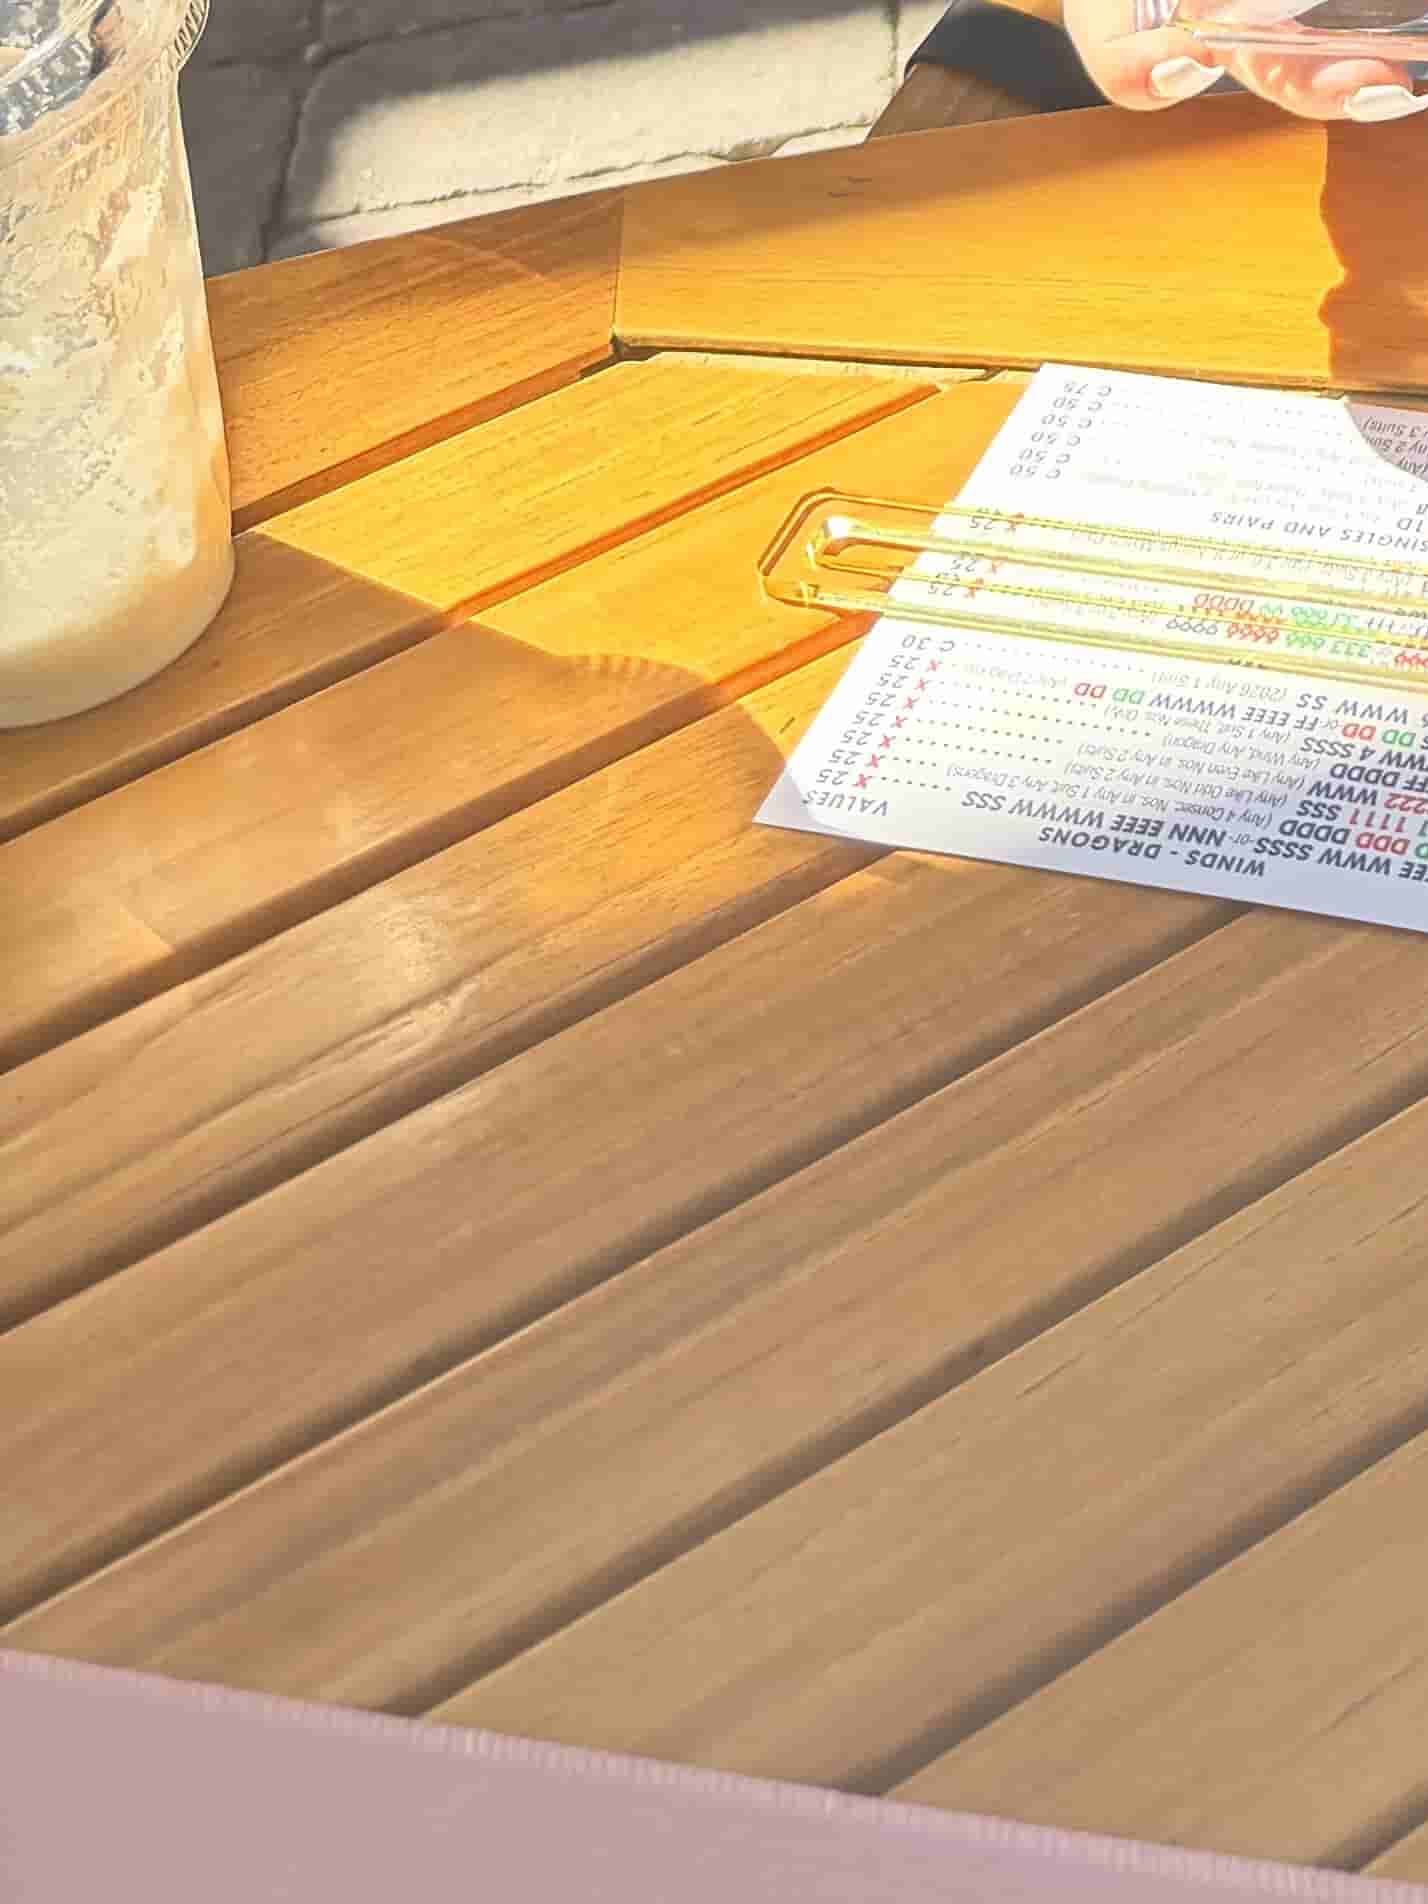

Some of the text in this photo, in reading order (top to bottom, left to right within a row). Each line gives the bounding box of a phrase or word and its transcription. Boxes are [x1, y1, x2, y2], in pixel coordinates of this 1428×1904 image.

[1283, 521, 1331, 537] AND
[1329, 763, 1400, 787] DDDD
[804, 789, 888, 816] VALUES
[1306, 780, 1378, 806] WWW
[1037, 826, 1162, 860] DRAGONS
[1184, 849, 1265, 877] WINDS
